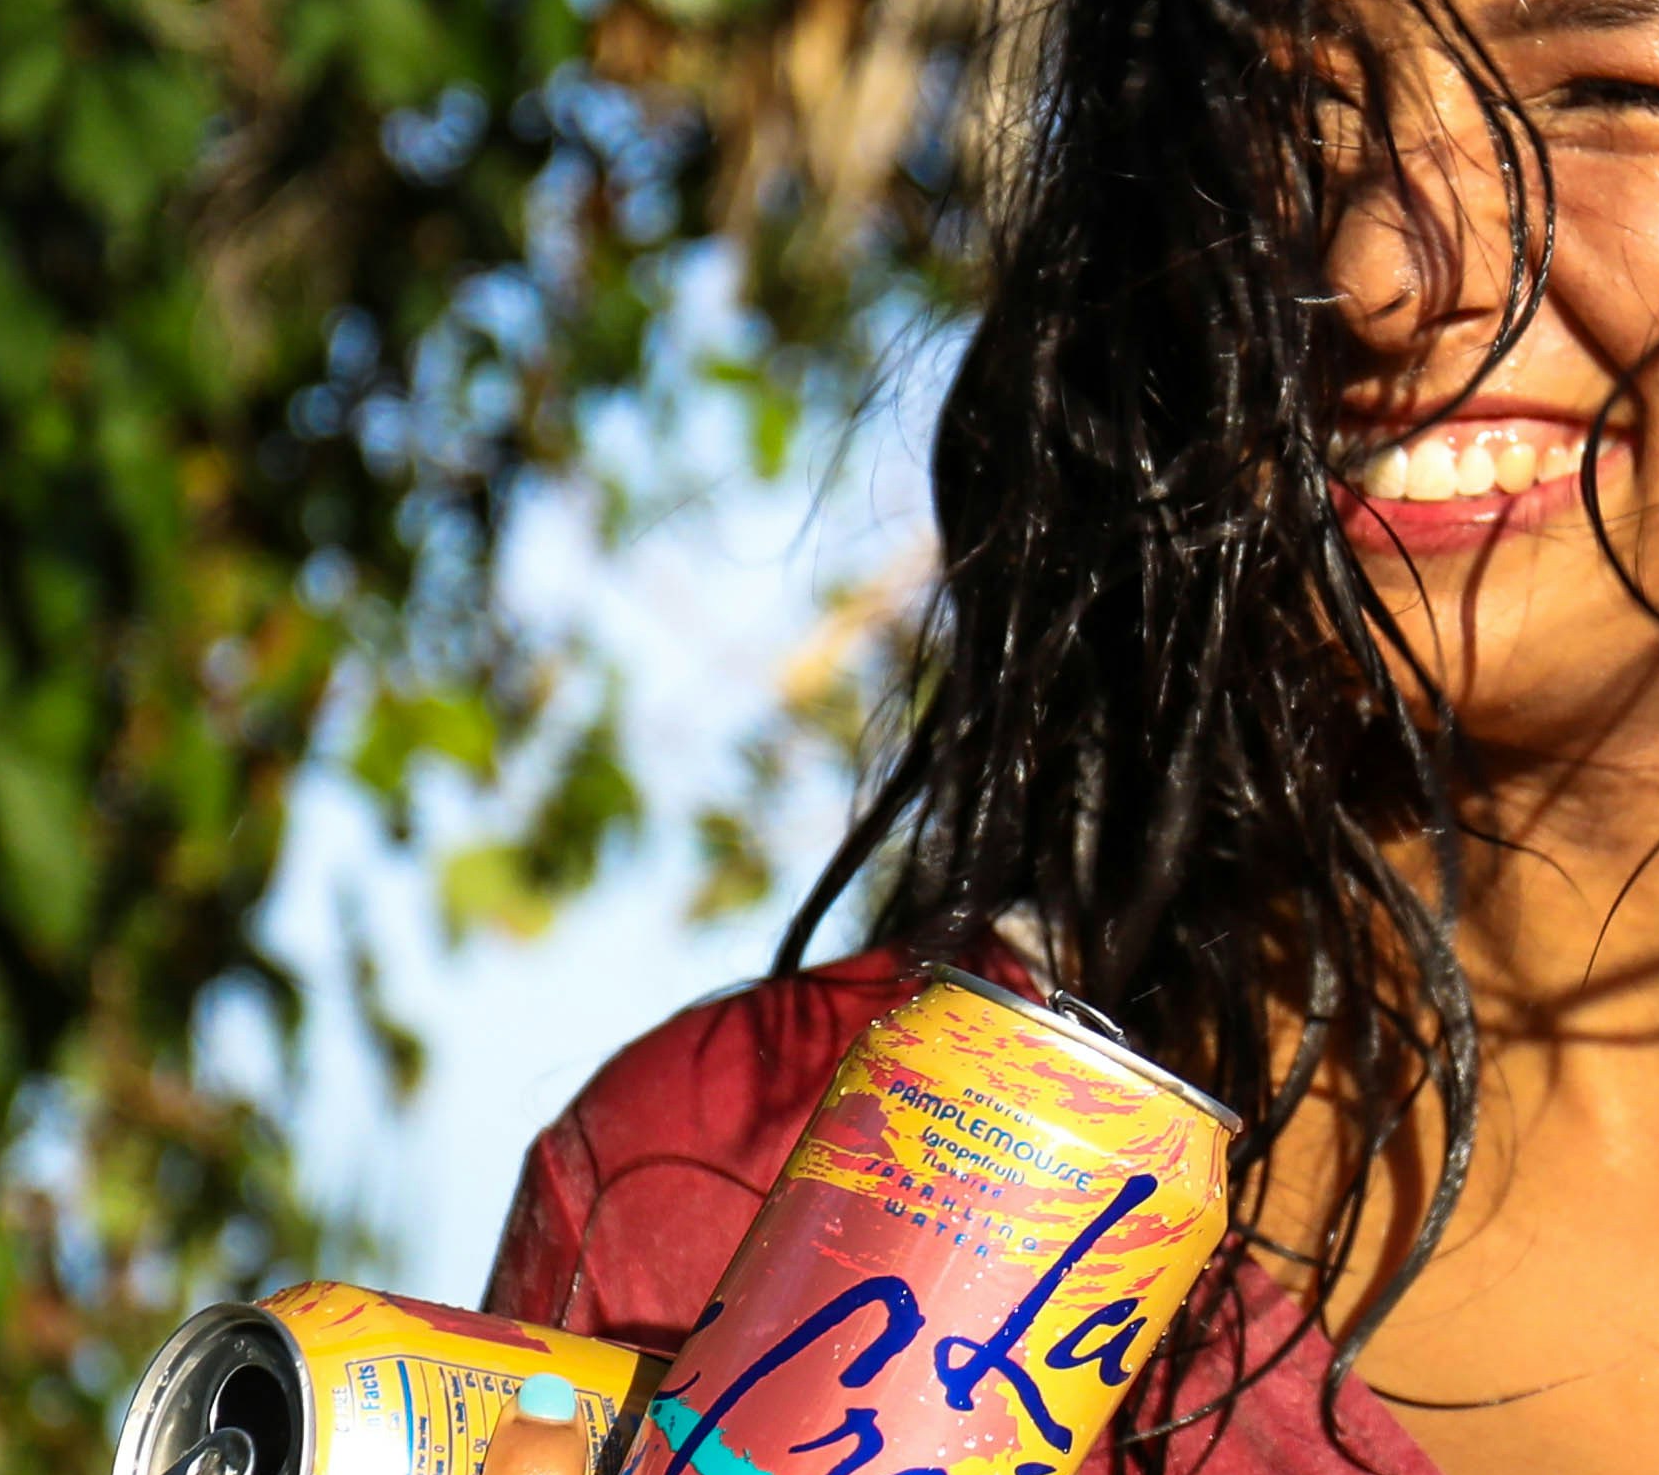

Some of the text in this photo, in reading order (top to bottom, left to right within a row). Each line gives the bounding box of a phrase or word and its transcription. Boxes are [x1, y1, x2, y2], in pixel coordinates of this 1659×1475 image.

[888, 1080, 1094, 1192] PAMPLEMOUSSE
[922, 1125, 1025, 1186] (grapefruit)
[922, 1153, 1003, 1198] flavored
[884, 1198, 988, 1257] WATER
[934, 1174, 1158, 1453] La
[357, 1364, 381, 1410] Facts
